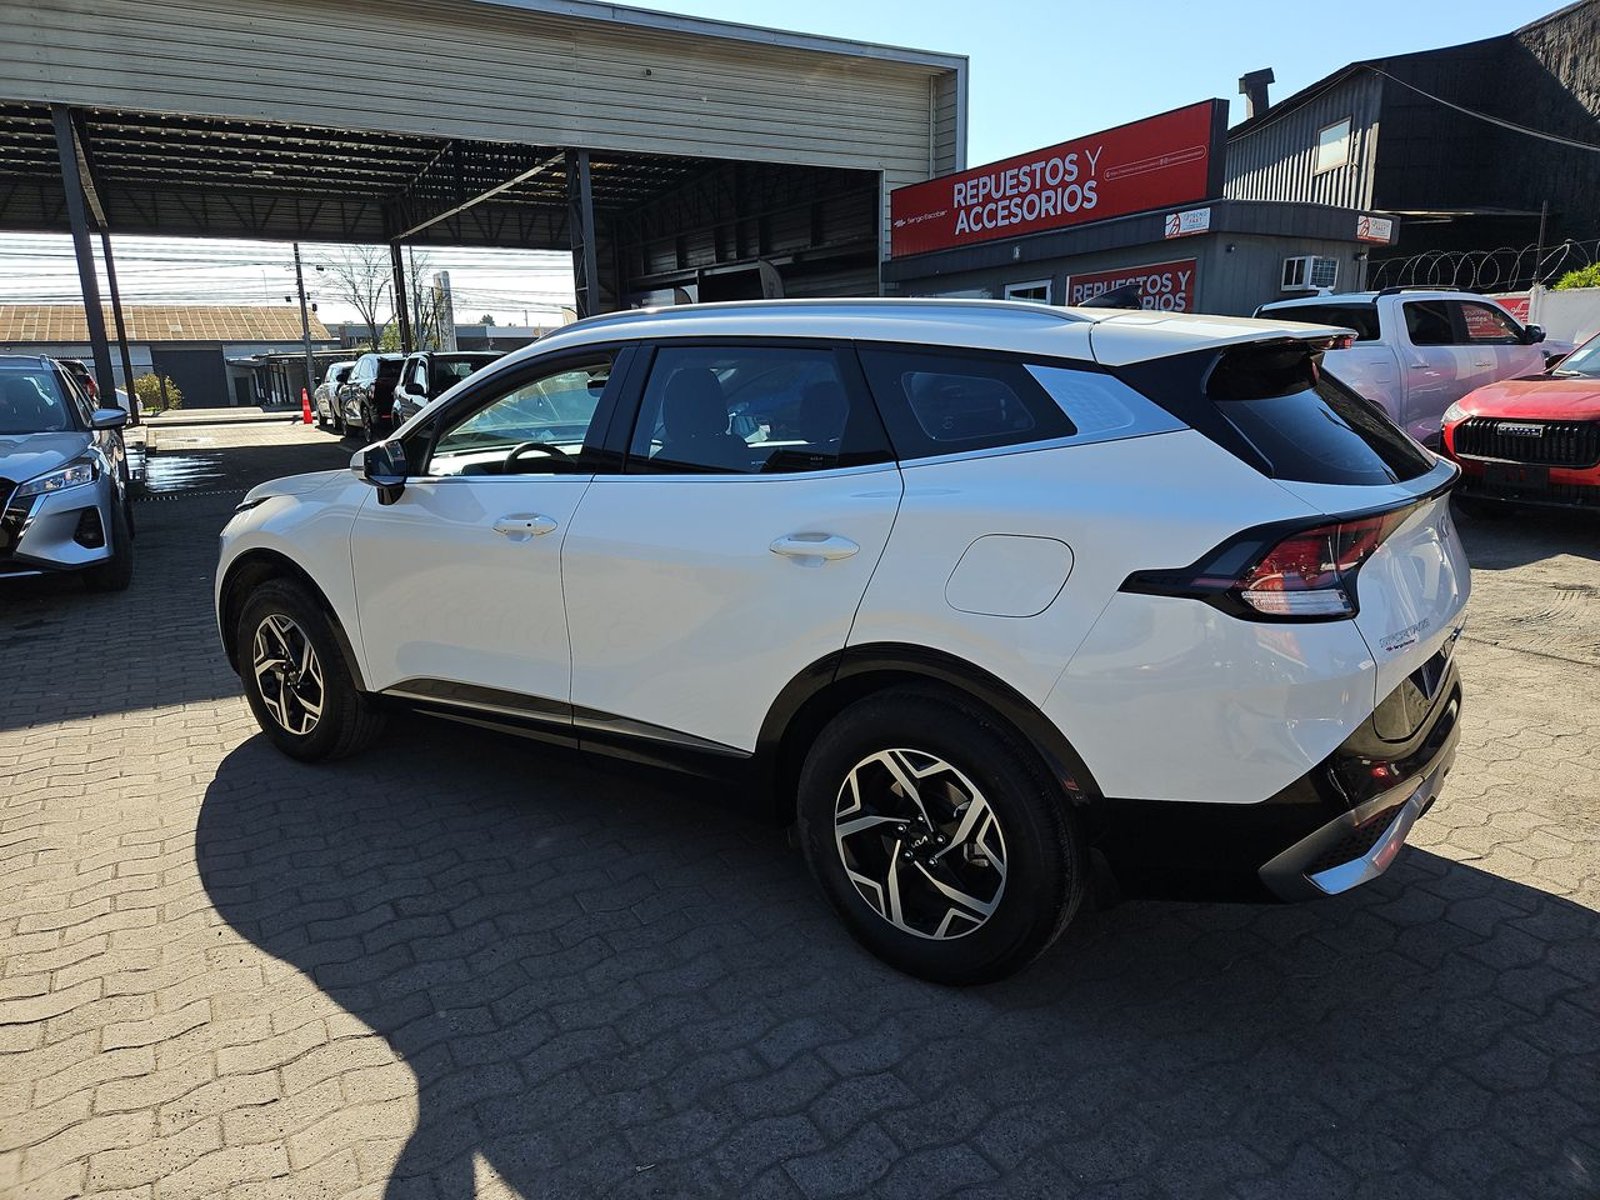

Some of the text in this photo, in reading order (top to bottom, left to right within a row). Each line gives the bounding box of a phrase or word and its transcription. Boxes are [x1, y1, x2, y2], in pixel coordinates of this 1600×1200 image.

[953, 153, 1079, 209] REPUESTOS
[1085, 145, 1103, 177] Y
[954, 180, 1098, 236] ACCESORIOS
[1177, 270, 1192, 291] Y
